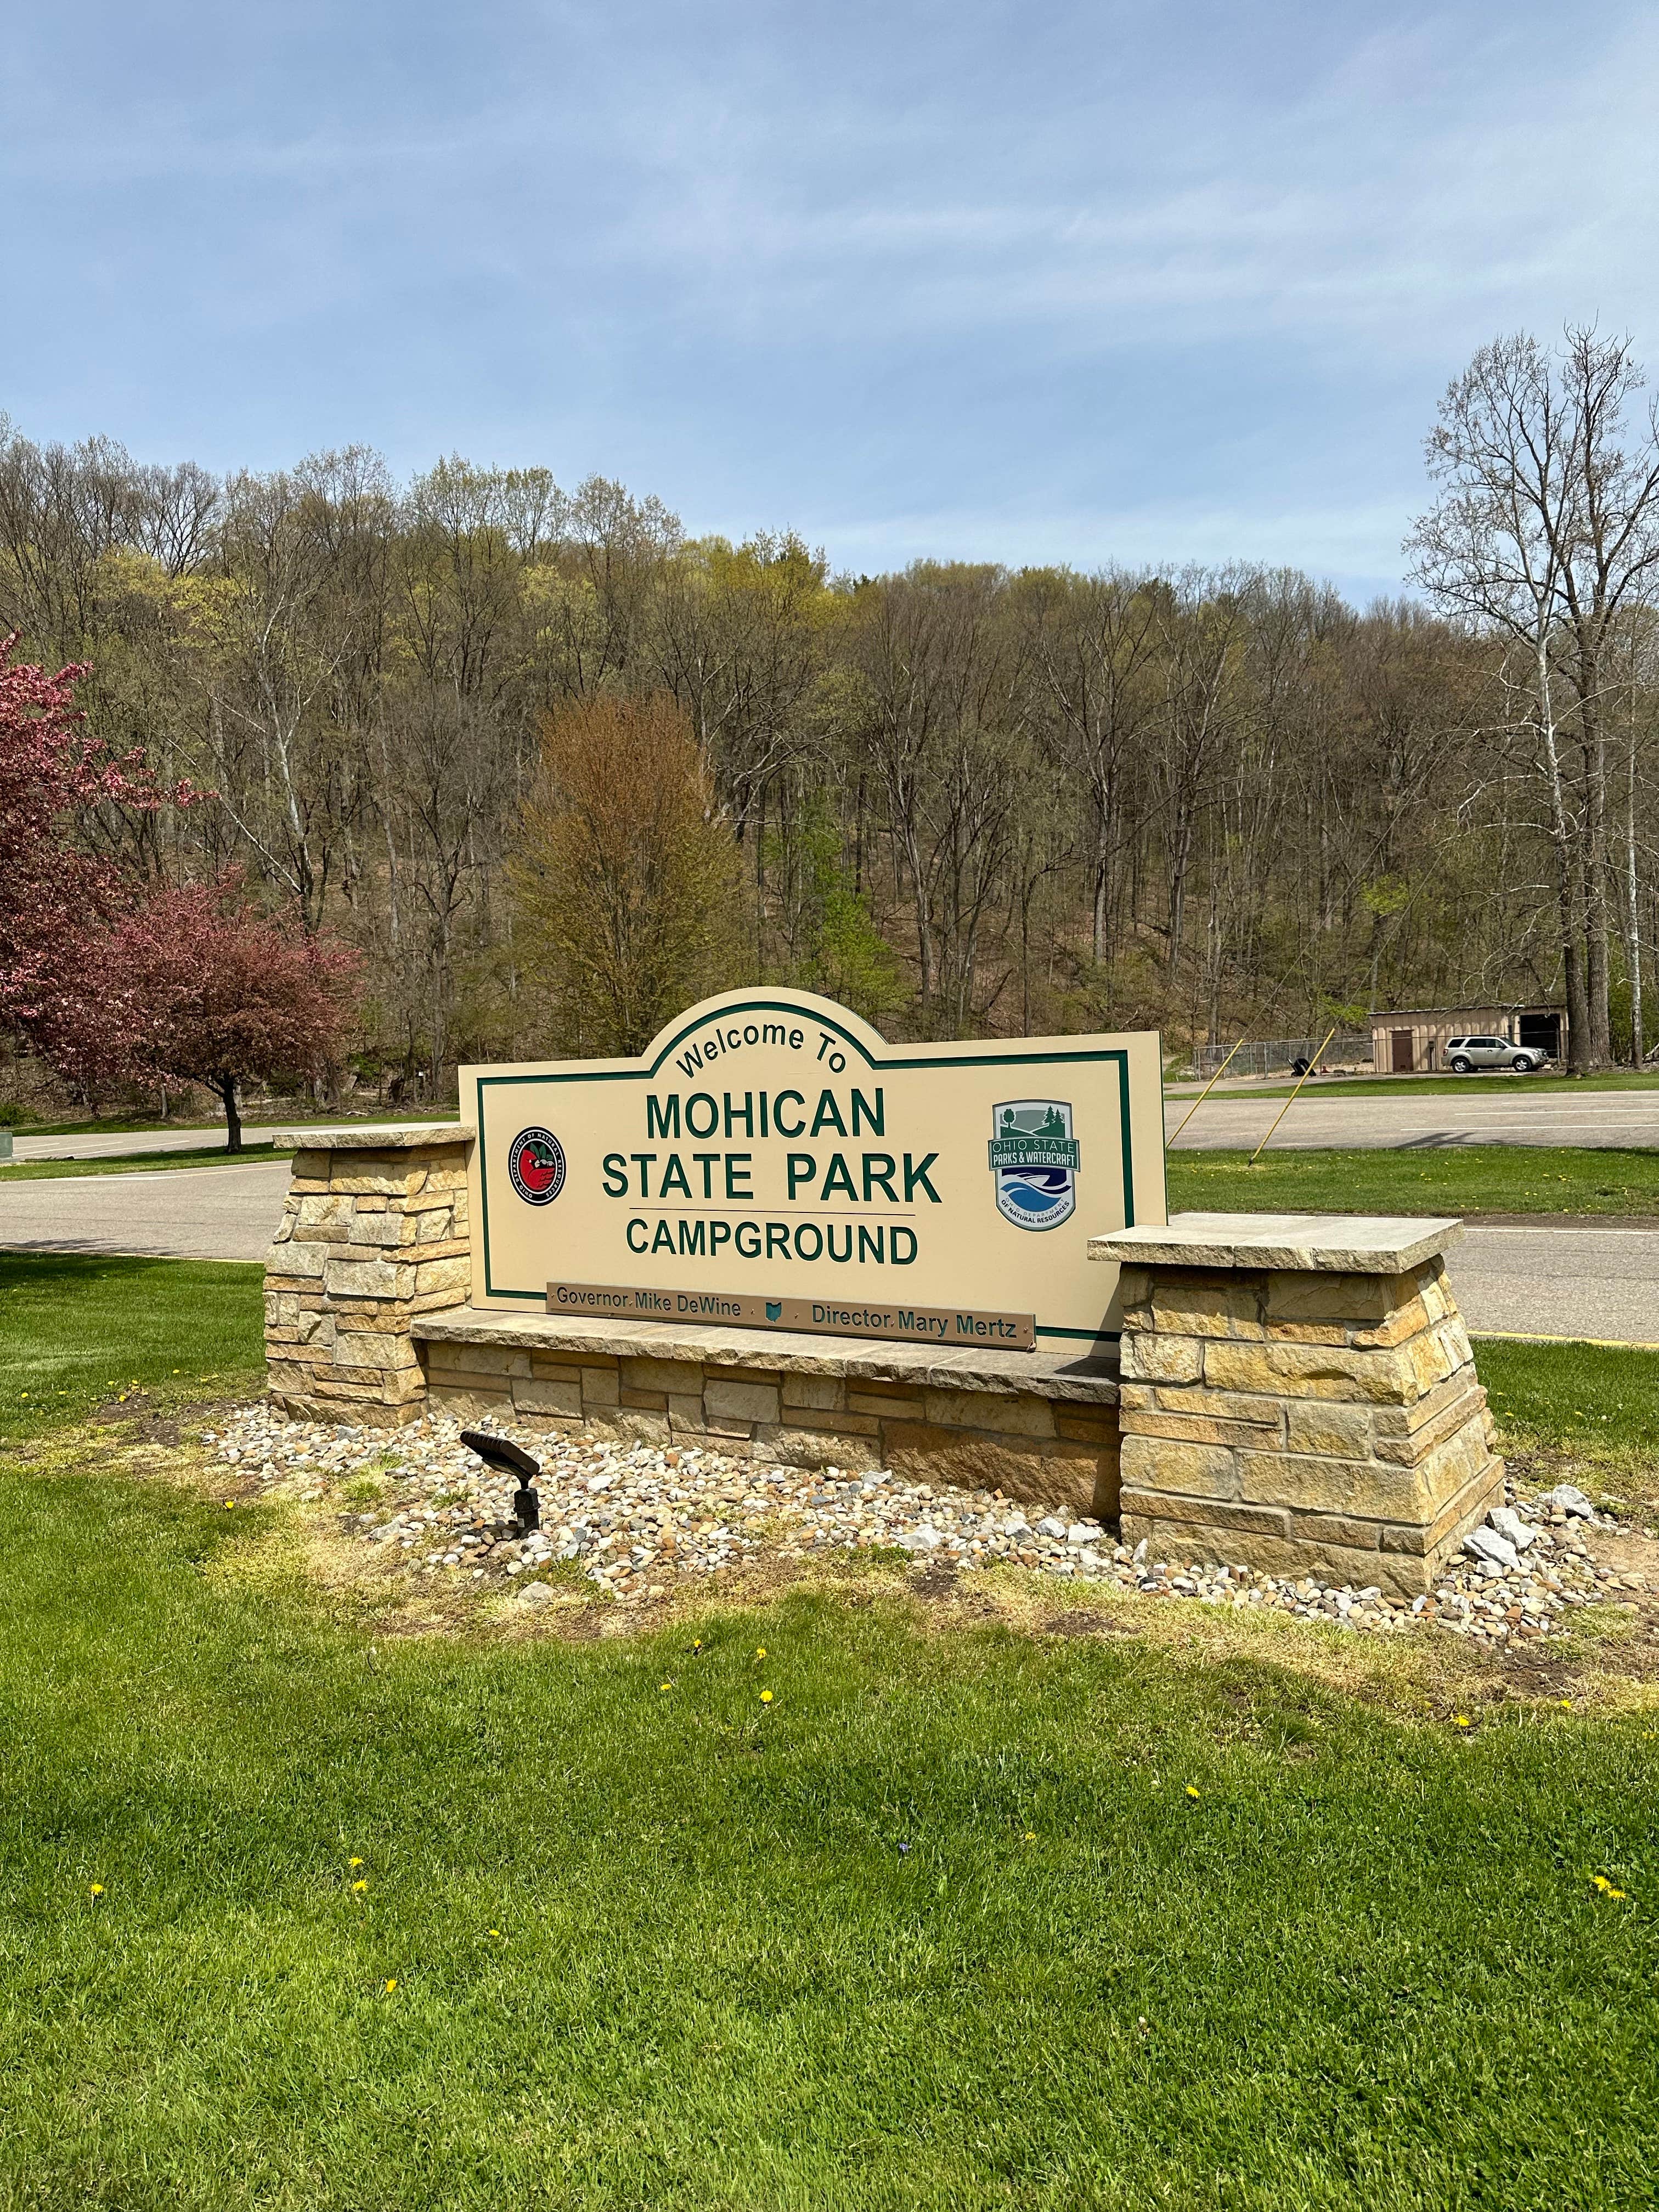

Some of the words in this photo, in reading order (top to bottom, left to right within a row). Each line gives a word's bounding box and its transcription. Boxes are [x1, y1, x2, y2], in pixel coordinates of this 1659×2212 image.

[676, 1024, 804, 1079] Welcome
[817, 1032, 846, 1073] To
[646, 1087, 885, 1139] MOHICAN
[513, 1138, 526, 1182] DEPARTMENT
[537, 1133, 559, 1156] NATURAL
[992, 1139, 1027, 1153] OHIO
[1034, 1139, 1075, 1153] STATE
[994, 1152, 1017, 1166] PARKS
[1019, 1152, 1025, 1163] &
[1026, 1151, 1075, 1166] WATERCRAFT
[520, 1185, 533, 1198] OHIO
[546, 1159, 562, 1197] RESOURCES
[602, 1153, 754, 1200] STATE
[787, 1153, 943, 1203] PARK
[1001, 1199, 1009, 1208] OF
[1008, 1207, 1036, 1223] NATURAL
[1037, 1201, 1070, 1223] RESOURCES
[1006, 1198, 1020, 1212] OHIO
[1024, 1198, 1065, 1217] DEPARTMENT
[627, 1218, 918, 1265] CAMPGROUND
[556, 1286, 628, 1308] Governor
[635, 1291, 672, 1312] Mike
[677, 1294, 741, 1317] DeWine
[812, 1304, 891, 1329] Director
[899, 1310, 949, 1338] Mary
[956, 1314, 1017, 1338] Mertz
